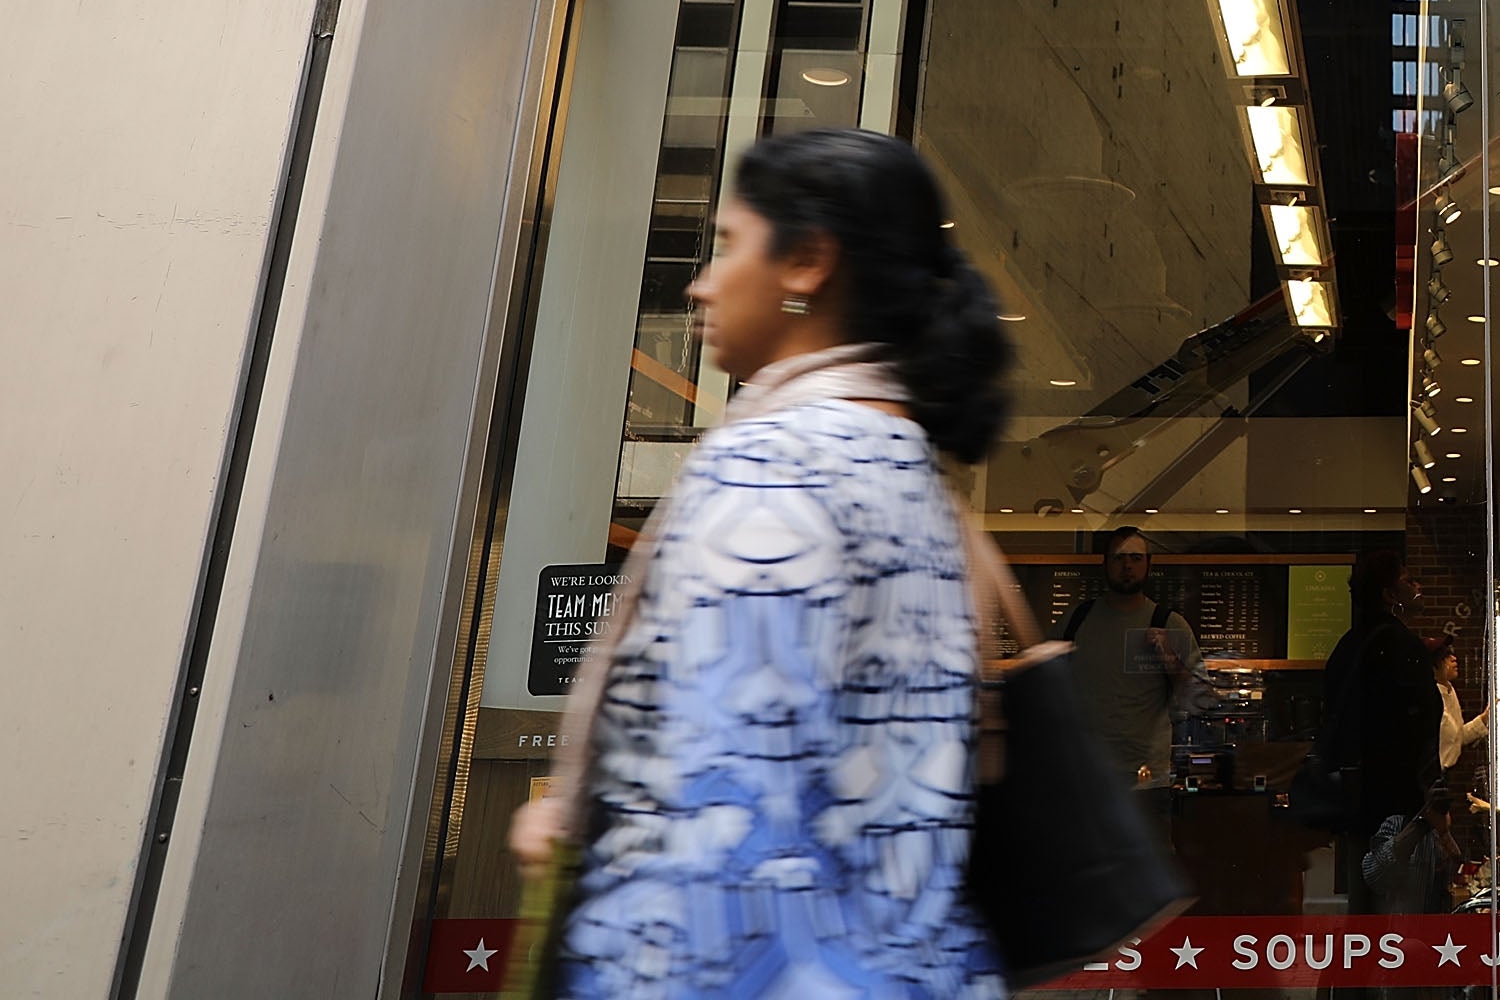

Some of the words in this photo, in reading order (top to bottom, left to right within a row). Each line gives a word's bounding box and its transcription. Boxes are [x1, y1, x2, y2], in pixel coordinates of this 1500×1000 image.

[550, 576, 586, 587] WE'RE
[588, 574, 633, 586] LOOKIN
[548, 593, 586, 619] TEAM
[545, 622, 582, 637] THIS
[557, 645, 579, 654] We've
[518, 735, 570, 748] FREE
[1231, 933, 1405, 970] SOUPS
